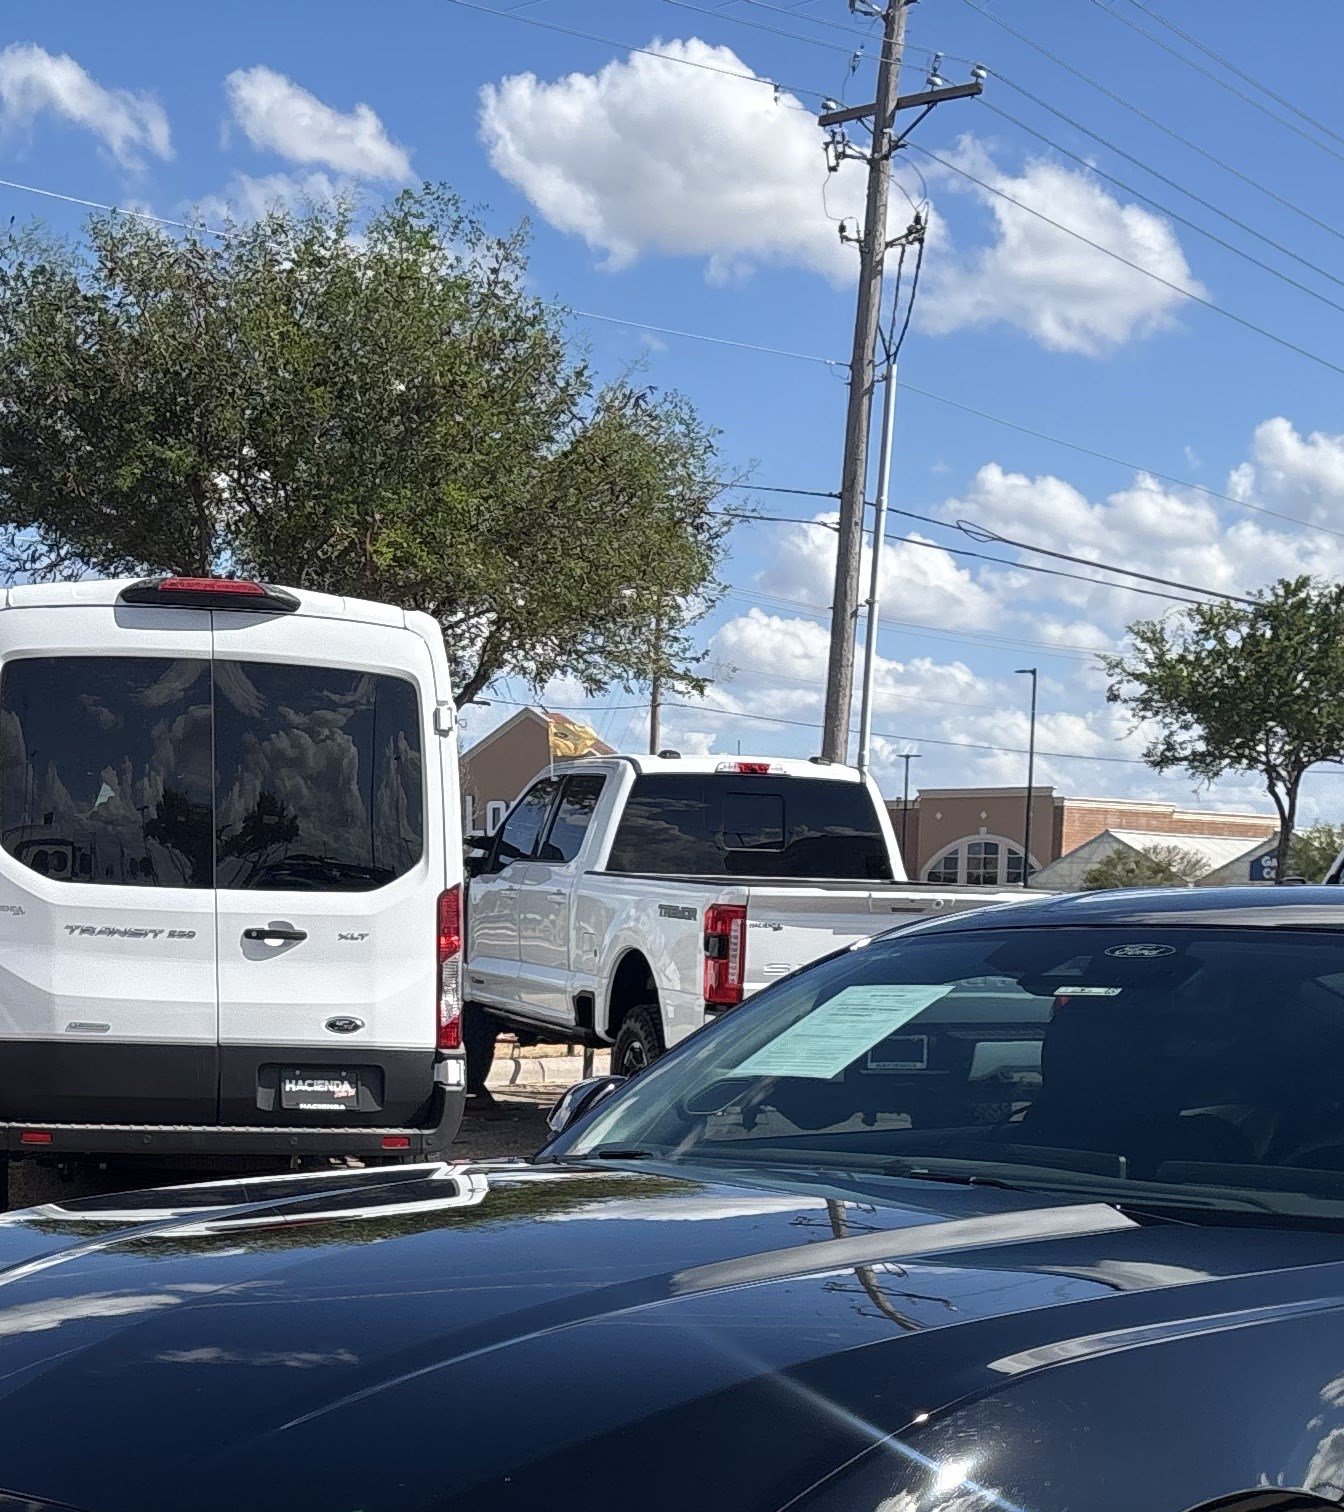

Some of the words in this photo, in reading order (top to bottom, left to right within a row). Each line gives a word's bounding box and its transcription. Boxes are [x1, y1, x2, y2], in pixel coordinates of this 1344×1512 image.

[64, 924, 165, 939] TRANSIT
[336, 932, 369, 941] XLT
[285, 1079, 352, 1092] HACIENDA
